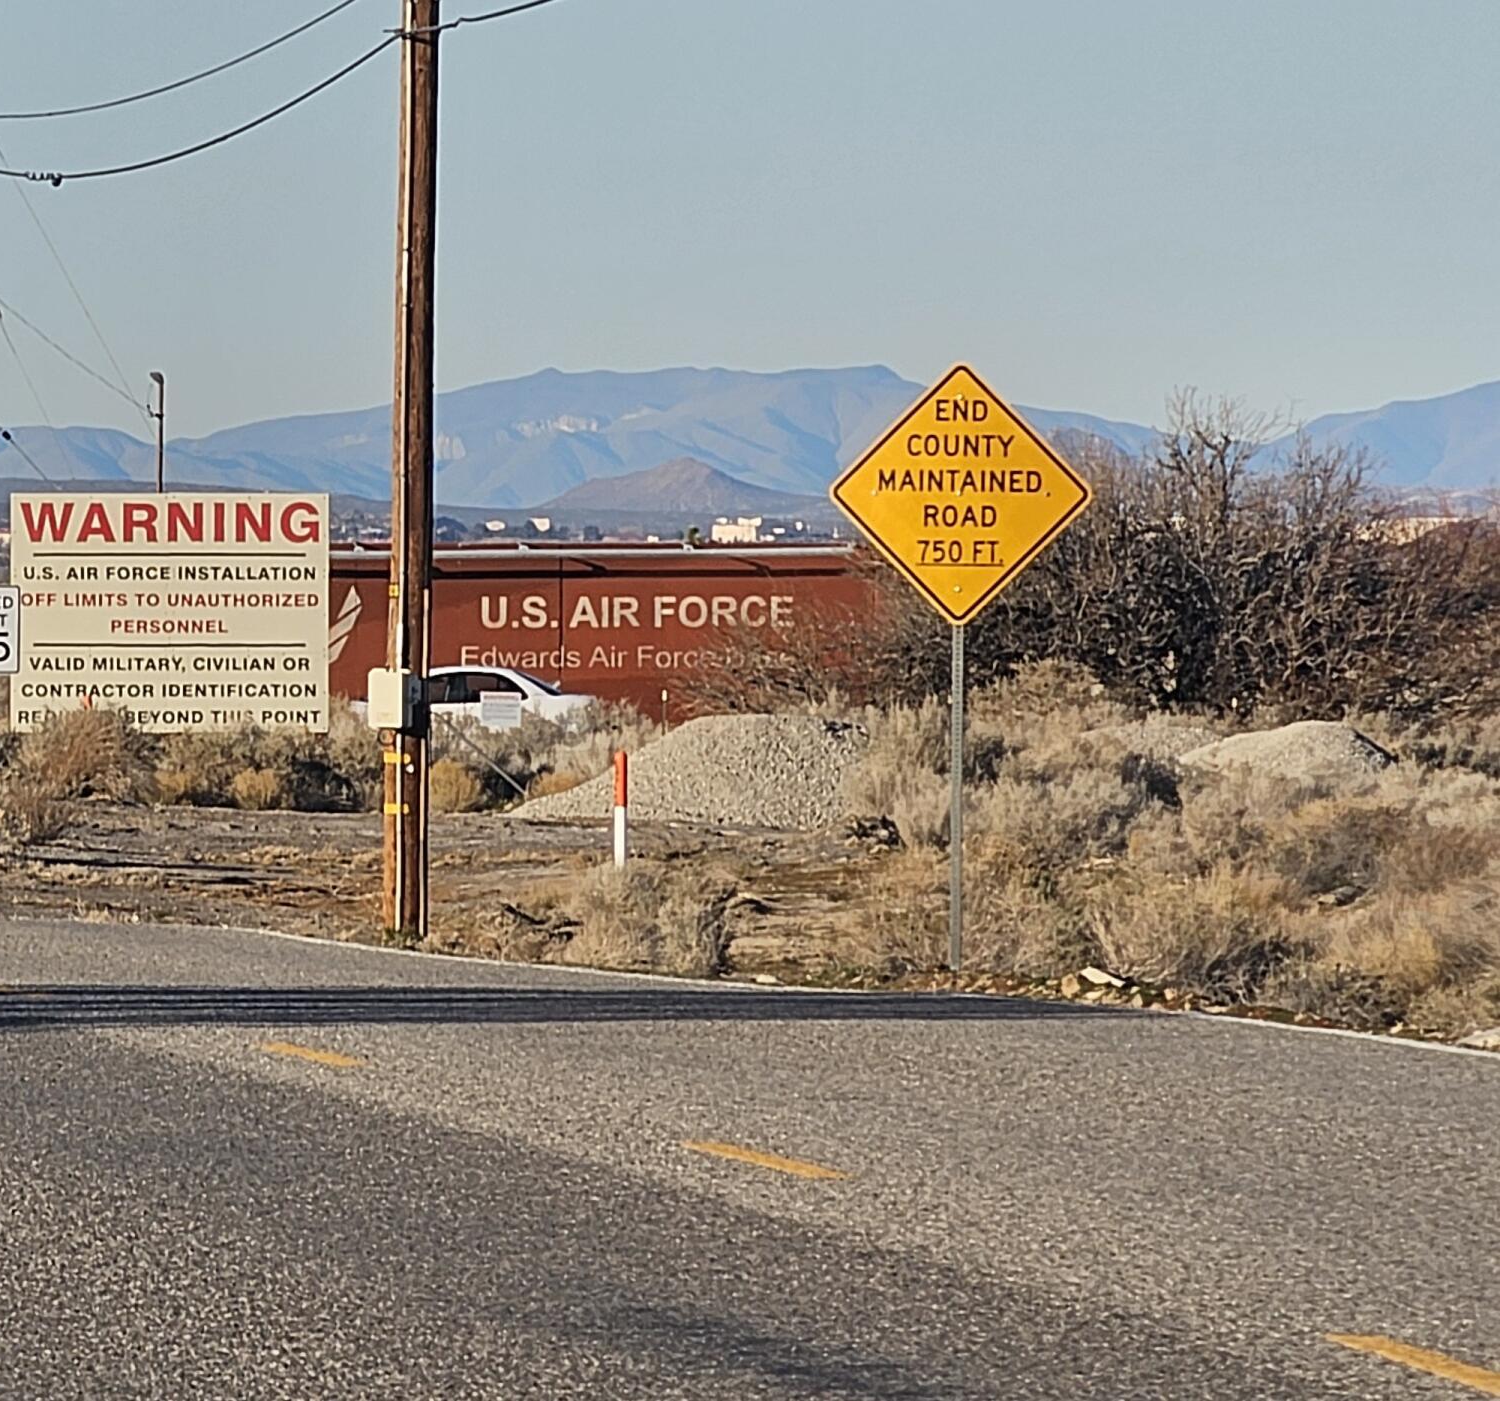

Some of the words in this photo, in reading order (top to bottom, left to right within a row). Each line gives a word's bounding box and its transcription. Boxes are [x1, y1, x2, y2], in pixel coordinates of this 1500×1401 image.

[936, 400, 988, 421] END
[907, 435, 1015, 457] COUNTY
[878, 469, 1042, 493] MAINTAINED
[20, 502, 320, 543] WARNING
[923, 505, 997, 527] ROAD
[917, 541, 963, 562] 750
[972, 541, 1004, 563] FT.
[23, 566, 60, 581] U.S.
[66, 566, 98, 580] AIR
[106, 566, 171, 580] FORCE
[178, 566, 317, 580] INSTALLATION
[21, 593, 57, 608] OFF
[63, 593, 128, 608] LIMITS
[135, 593, 160, 608] TO
[167, 593, 319, 608] UNAUTHORIZED
[480, 596, 558, 628] U.S.
[569, 596, 640, 628] AIR
[654, 596, 794, 628] FORCE
[111, 620, 229, 633] PERSONNEL
[30, 657, 85, 671] VALID
[92, 657, 186, 673] MILITARY,
[193, 657, 276, 671] CIVILIAN
[283, 657, 310, 671] OR
[460, 645, 581, 668] Edwards
[588, 645, 628, 668] Air
[21, 684, 154, 698] CONTRACTOR
[162, 684, 317, 698] IDENTIFICATION
[125, 711, 203, 724] BEYOND
[262, 711, 321, 724] POINT
